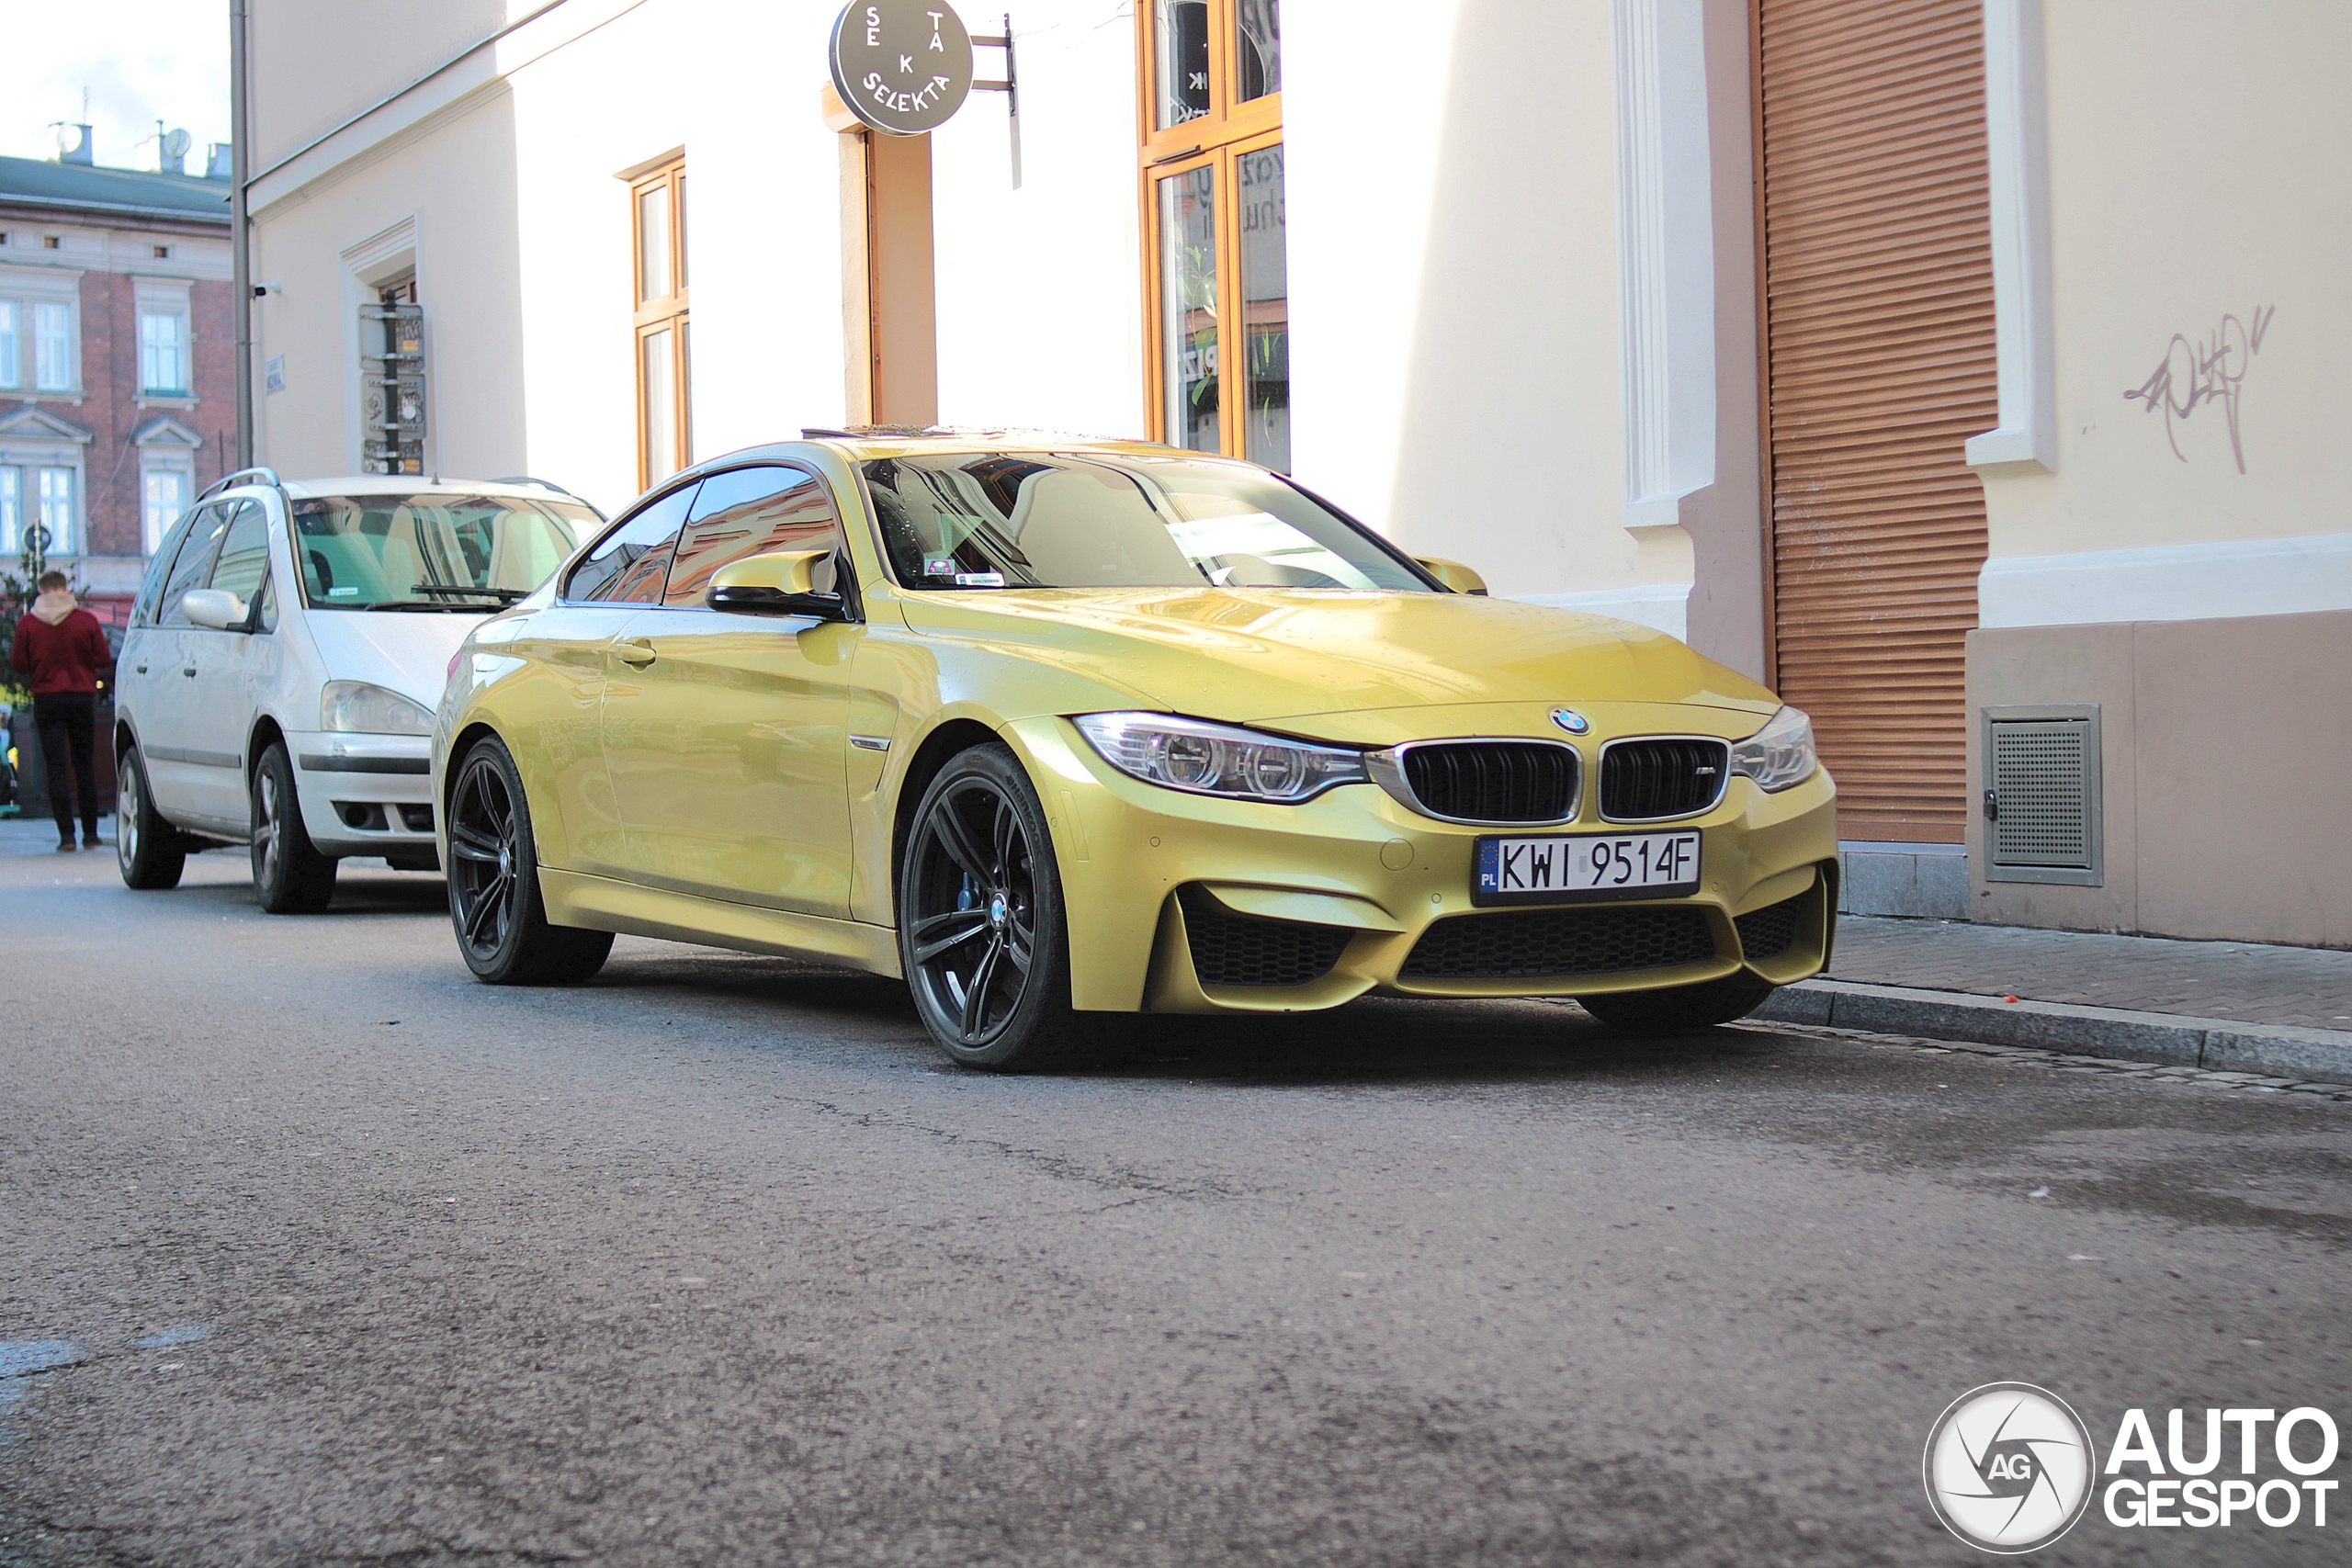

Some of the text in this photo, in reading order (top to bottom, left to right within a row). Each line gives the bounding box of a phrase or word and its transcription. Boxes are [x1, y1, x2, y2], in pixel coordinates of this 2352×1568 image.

[863, 72, 950, 112] SELEKTA
[1481, 874, 1497, 887] PL
[1503, 837, 1694, 889] KWI 9514F
